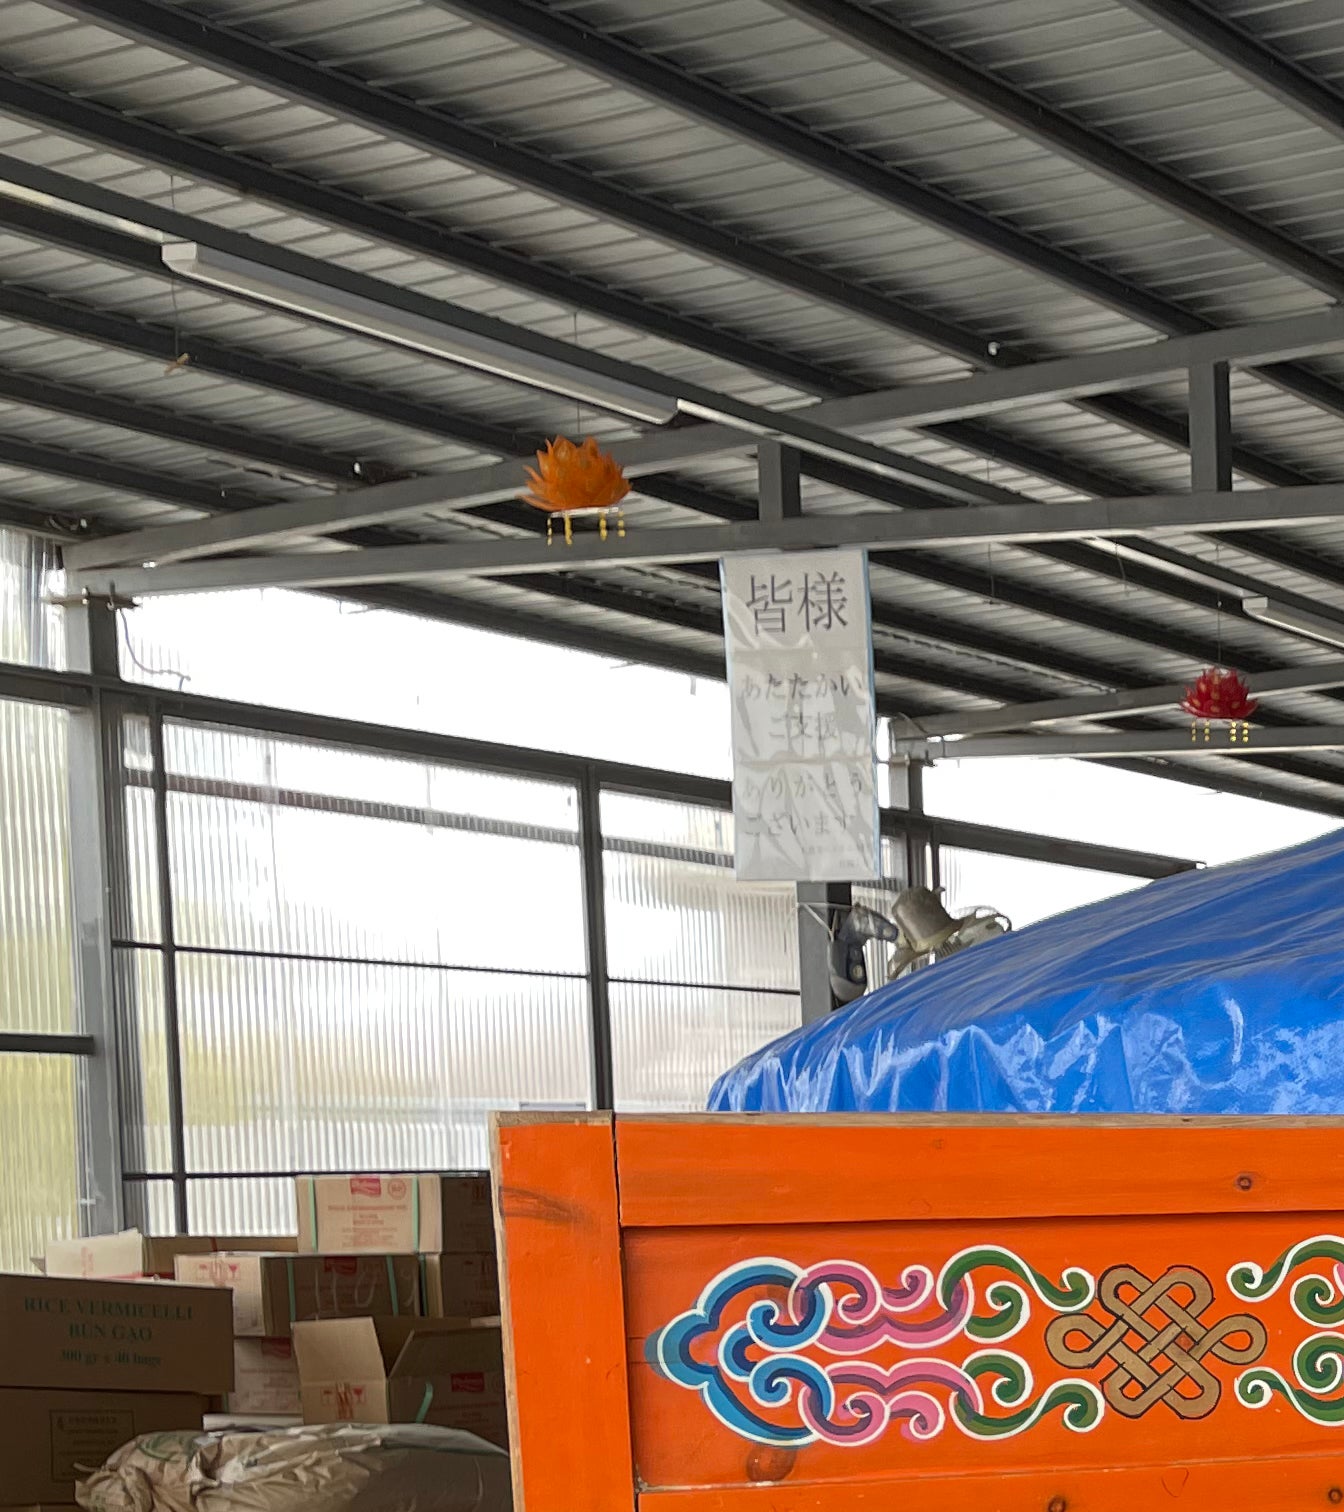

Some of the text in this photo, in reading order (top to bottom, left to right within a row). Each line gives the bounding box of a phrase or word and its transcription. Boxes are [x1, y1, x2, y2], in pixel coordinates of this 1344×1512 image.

[746, 571, 849, 636] 皆様
[742, 672, 866, 702] あたたかい
[742, 771, 863, 799] ありがとう
[23, 1296, 194, 1322] RICE VERMICELLI
